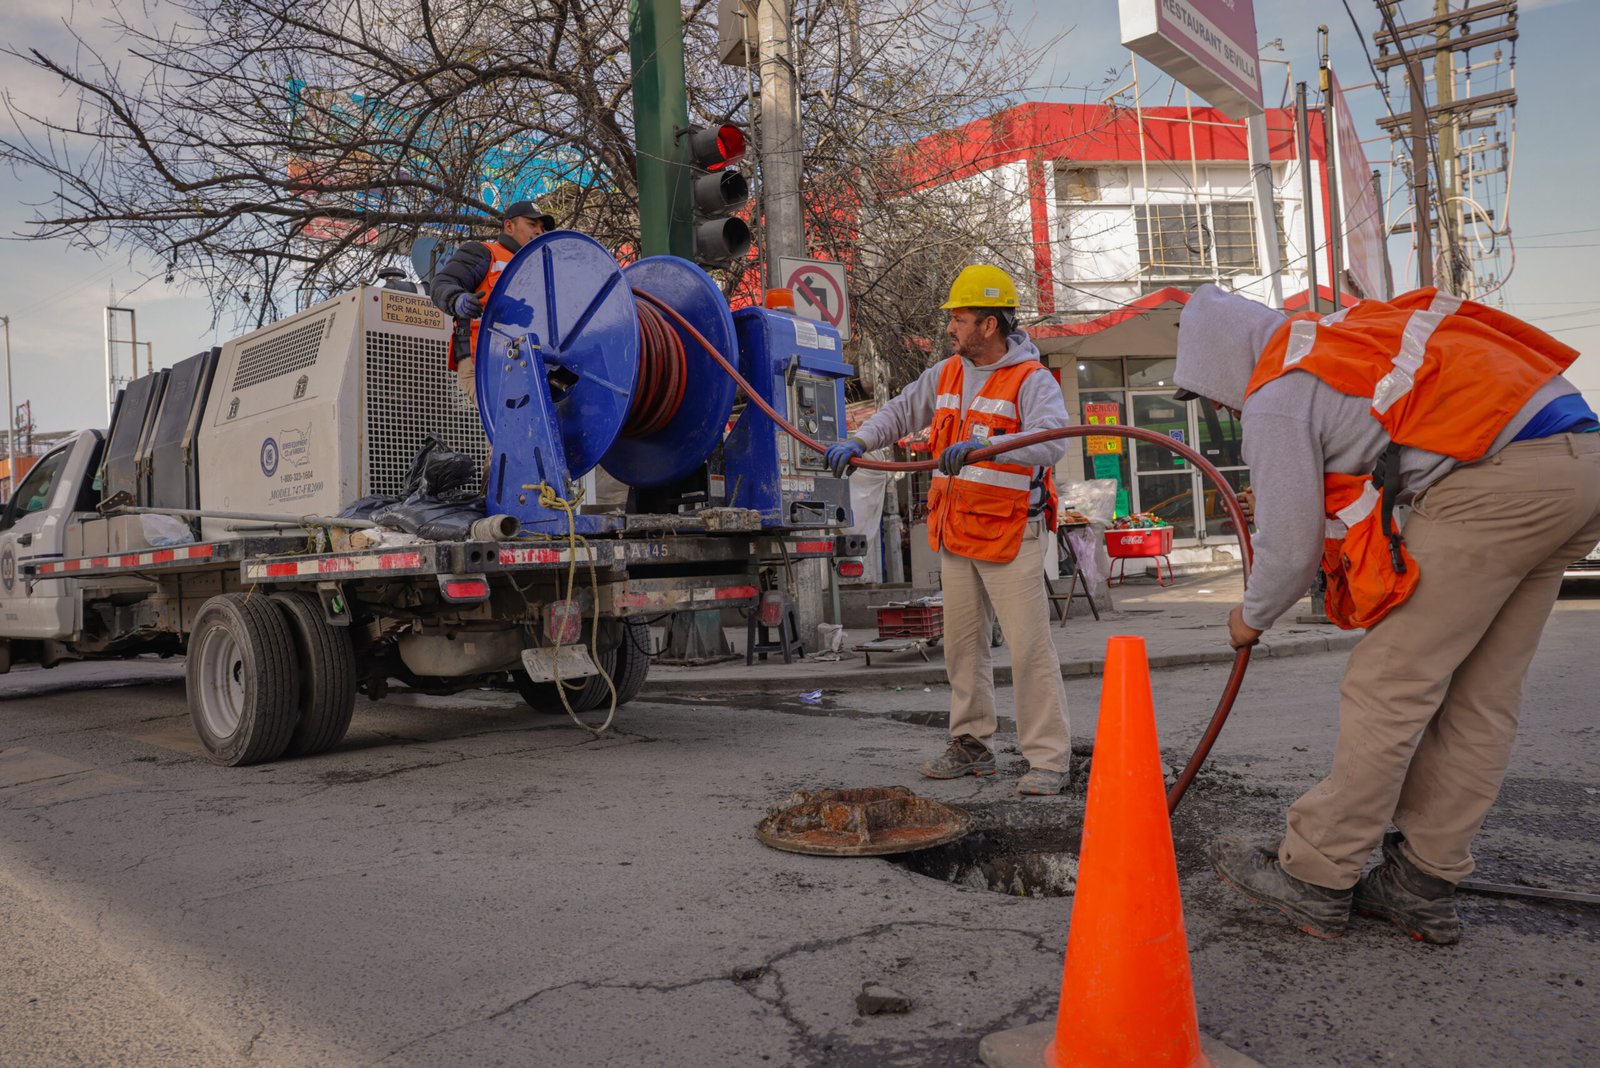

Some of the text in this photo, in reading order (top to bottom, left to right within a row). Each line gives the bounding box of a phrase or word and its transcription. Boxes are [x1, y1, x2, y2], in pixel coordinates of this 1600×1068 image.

[1162, 0, 1256, 81] RESTAURANT SEVILLA
[389, 295, 437, 309] REPORTAM
[386, 304, 440, 318] POR MAL USO
[386, 312, 441, 327] TEL. 2033-6767
[271, 486, 291, 500] MODEL
[1120, 535, 1144, 545] Coca-Cola
